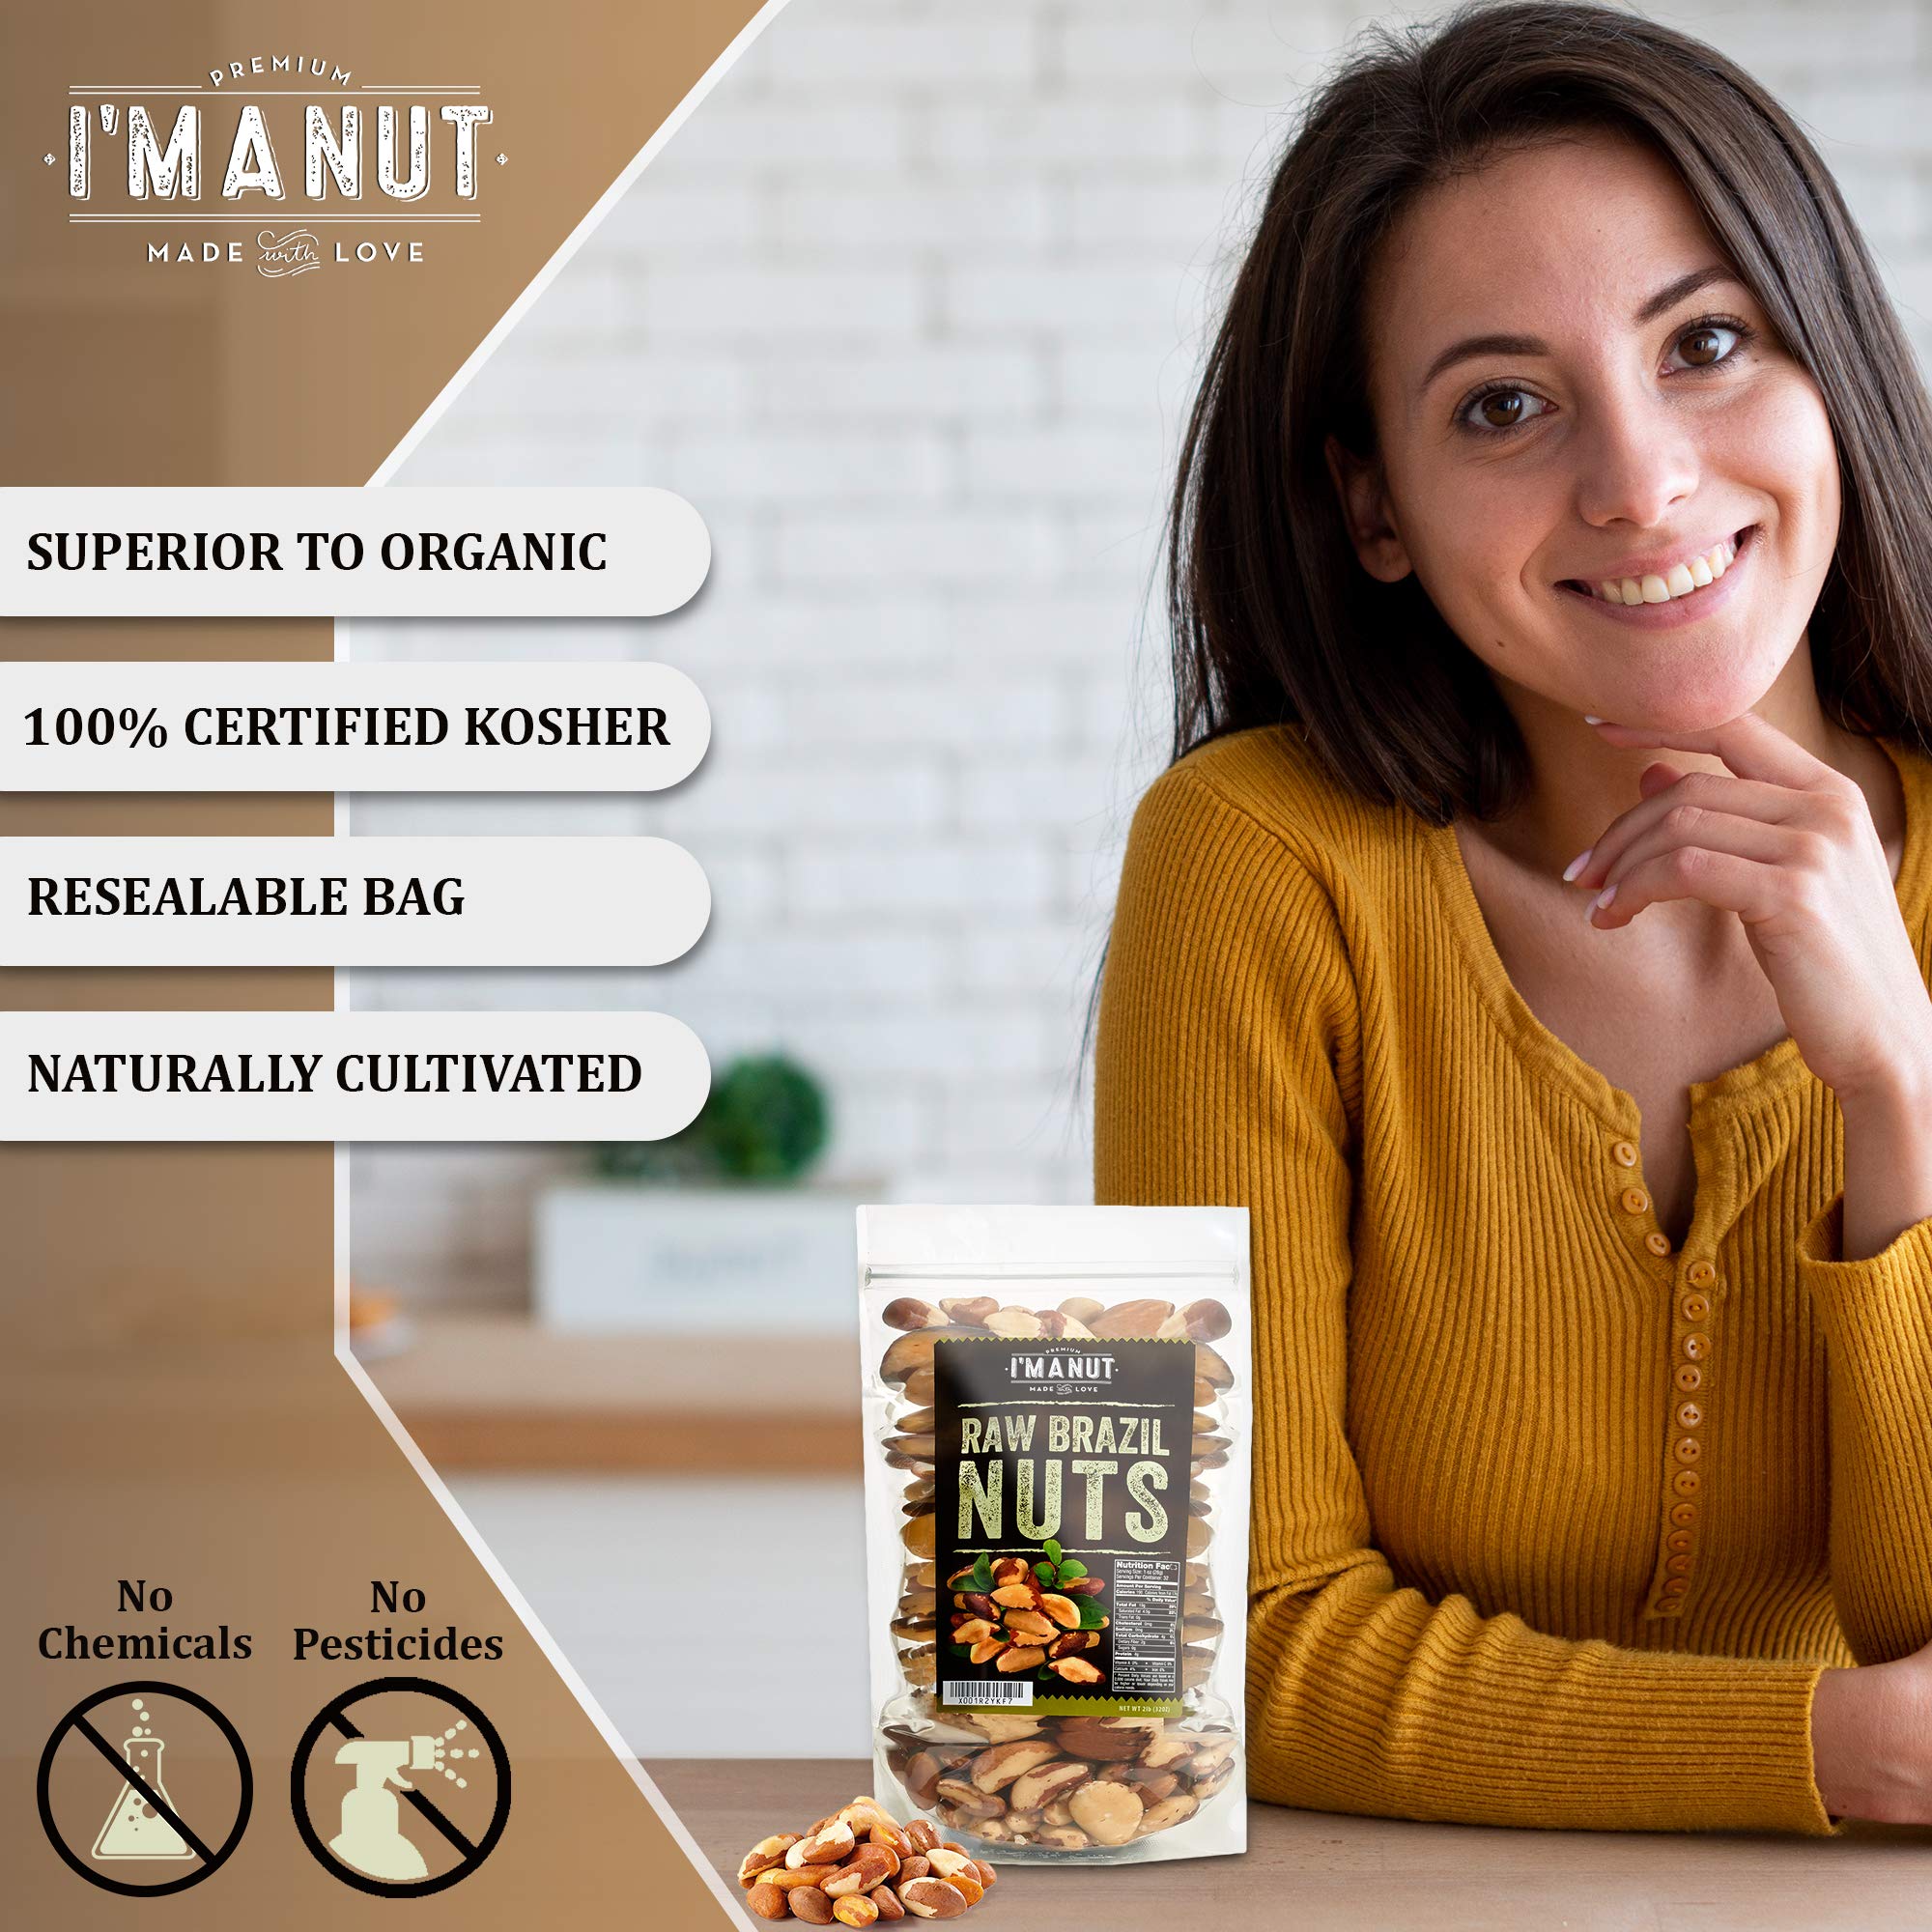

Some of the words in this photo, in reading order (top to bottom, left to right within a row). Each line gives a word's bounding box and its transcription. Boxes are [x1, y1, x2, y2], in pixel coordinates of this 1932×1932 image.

[1010, 1357, 1044, 1378] I'M
[1047, 1357, 1065, 1378] A
[1068, 1357, 1116, 1379] NUT
[960, 1415, 1037, 1454] RAW
[1048, 1415, 1171, 1456] BRAZIL
[957, 1459, 1169, 1543] NUTS
[1117, 1561, 1153, 1570] Nutrition
